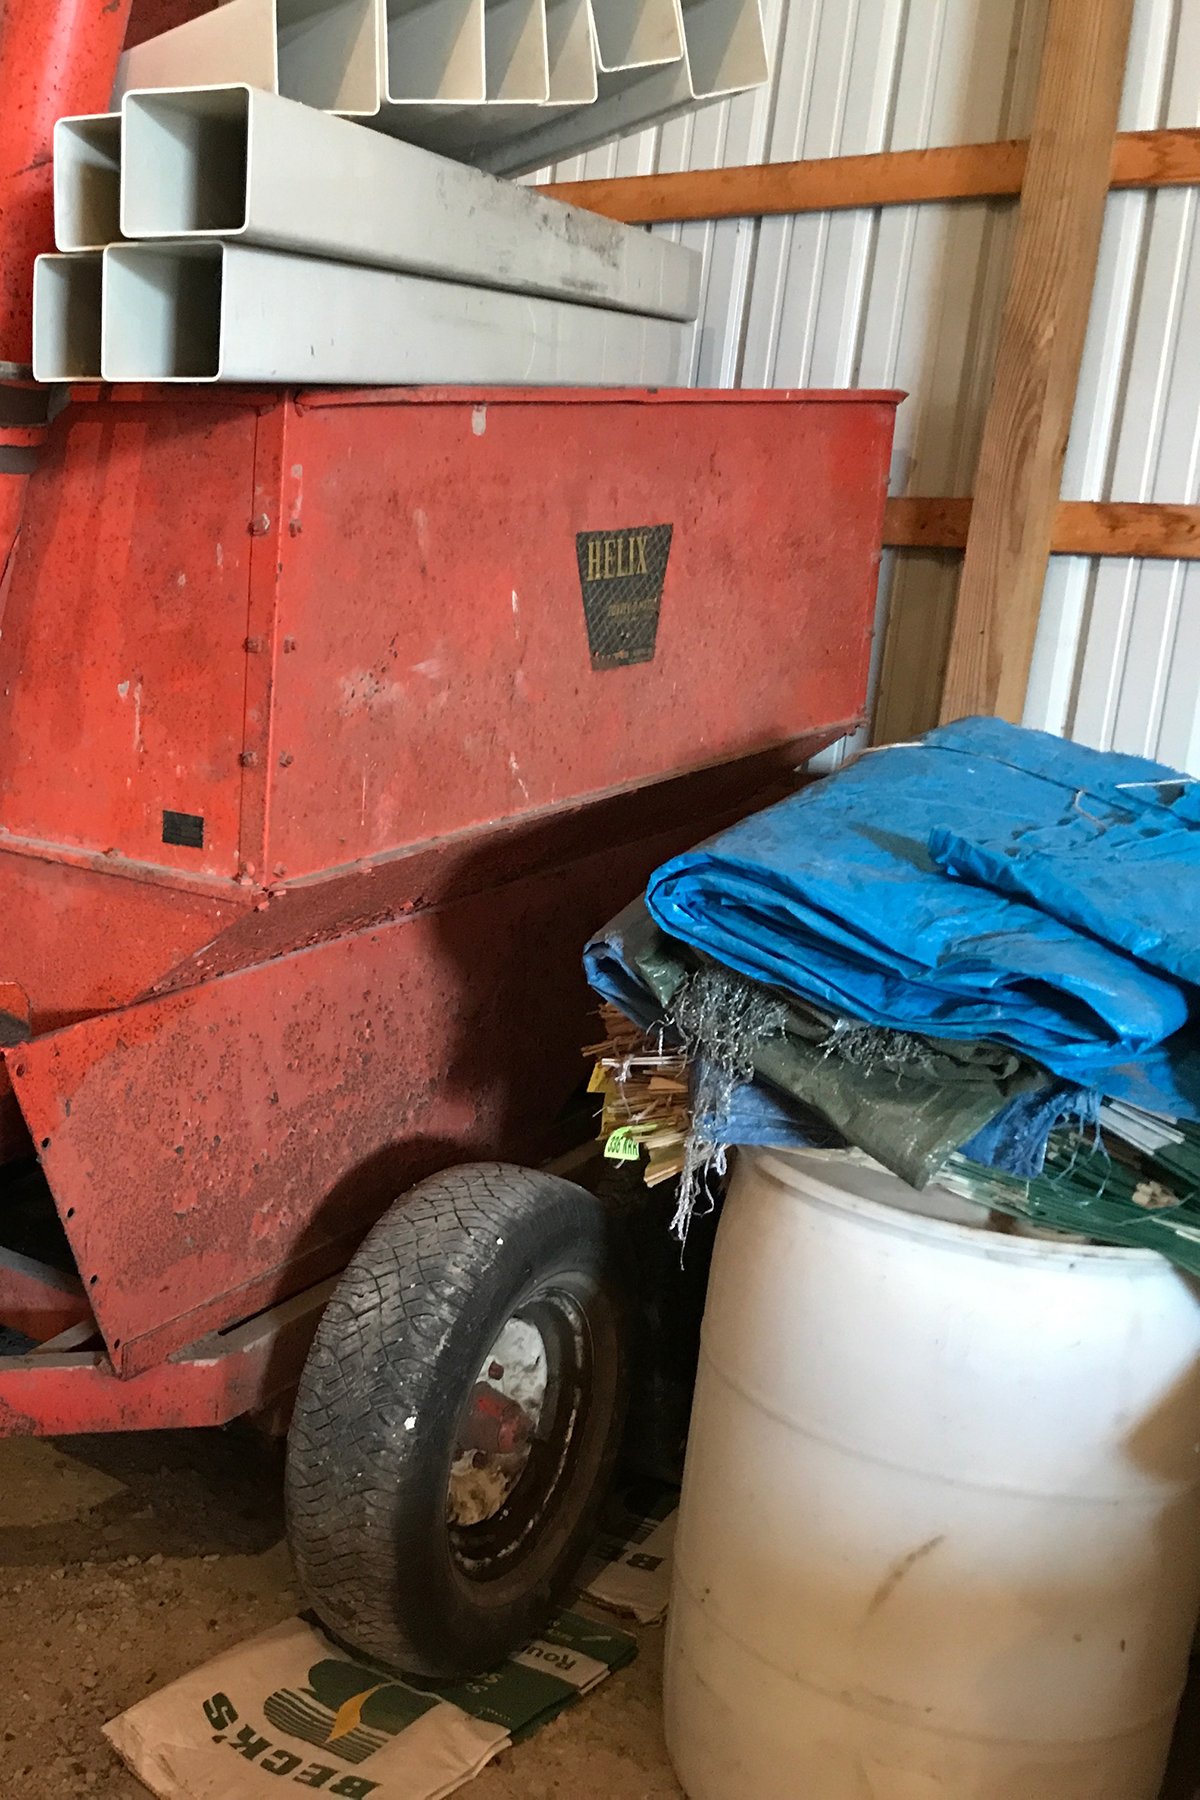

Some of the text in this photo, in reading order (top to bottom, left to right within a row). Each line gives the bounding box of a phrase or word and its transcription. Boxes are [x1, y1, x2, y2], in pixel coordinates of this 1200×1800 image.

[586, 535, 649, 582] HELIX
[521, 1645, 577, 1671] Rou
[202, 1691, 384, 1800] BECK'S
